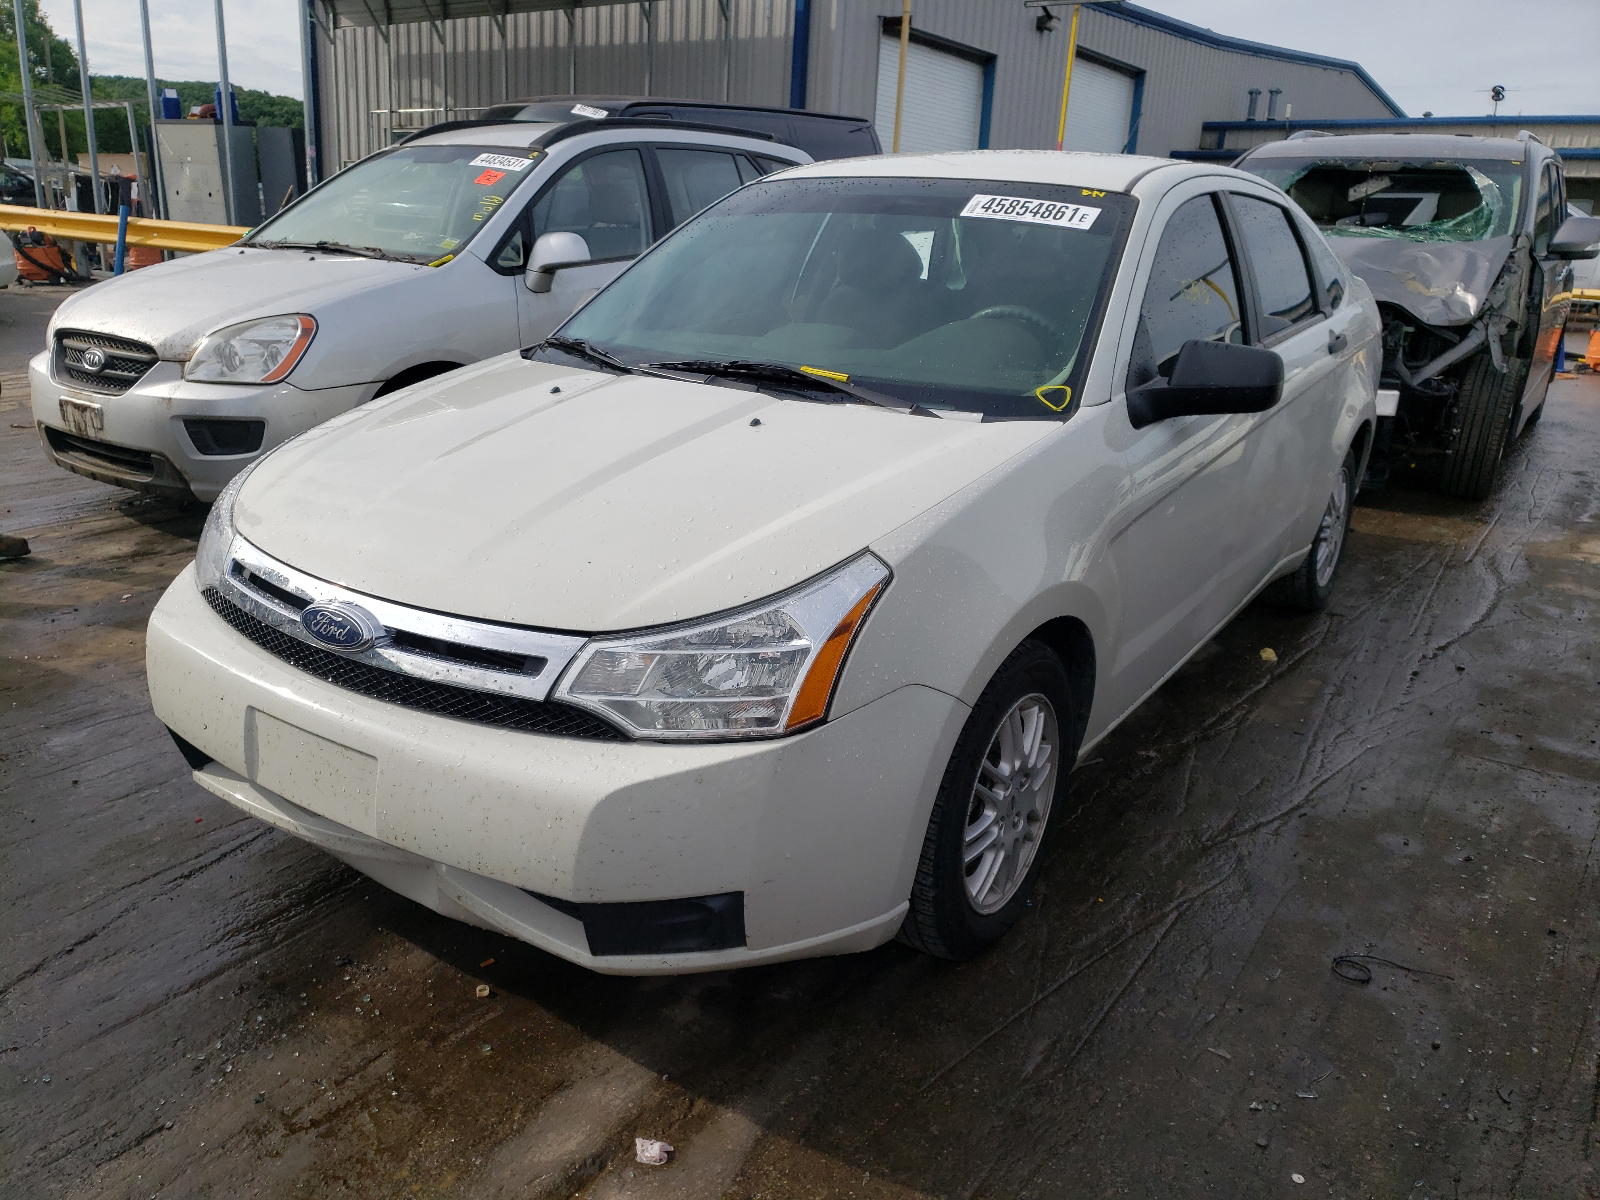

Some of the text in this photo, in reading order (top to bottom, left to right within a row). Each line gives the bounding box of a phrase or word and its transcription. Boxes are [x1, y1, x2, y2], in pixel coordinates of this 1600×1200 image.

[981, 197, 1080, 223] 45854861
[84, 353, 100, 366] KIA
[311, 611, 351, 641] Ford
